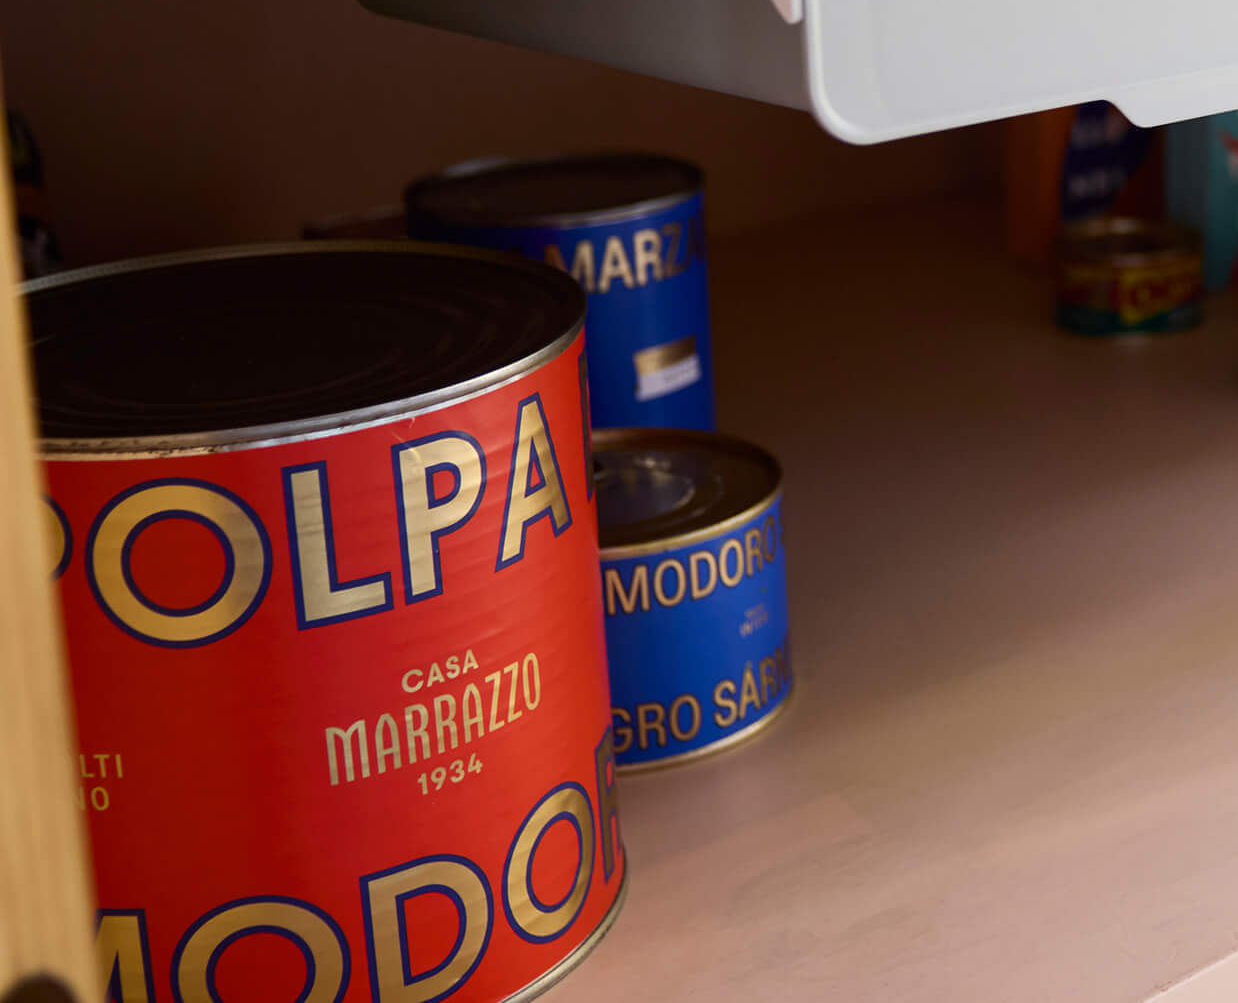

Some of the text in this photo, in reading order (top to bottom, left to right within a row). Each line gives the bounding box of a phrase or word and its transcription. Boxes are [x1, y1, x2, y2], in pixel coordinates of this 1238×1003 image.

[43, 392, 573, 649] OLPA
[401, 649, 480, 693] CASA
[325, 652, 542, 786] MARRAZZO
[417, 754, 484, 796] 1934
